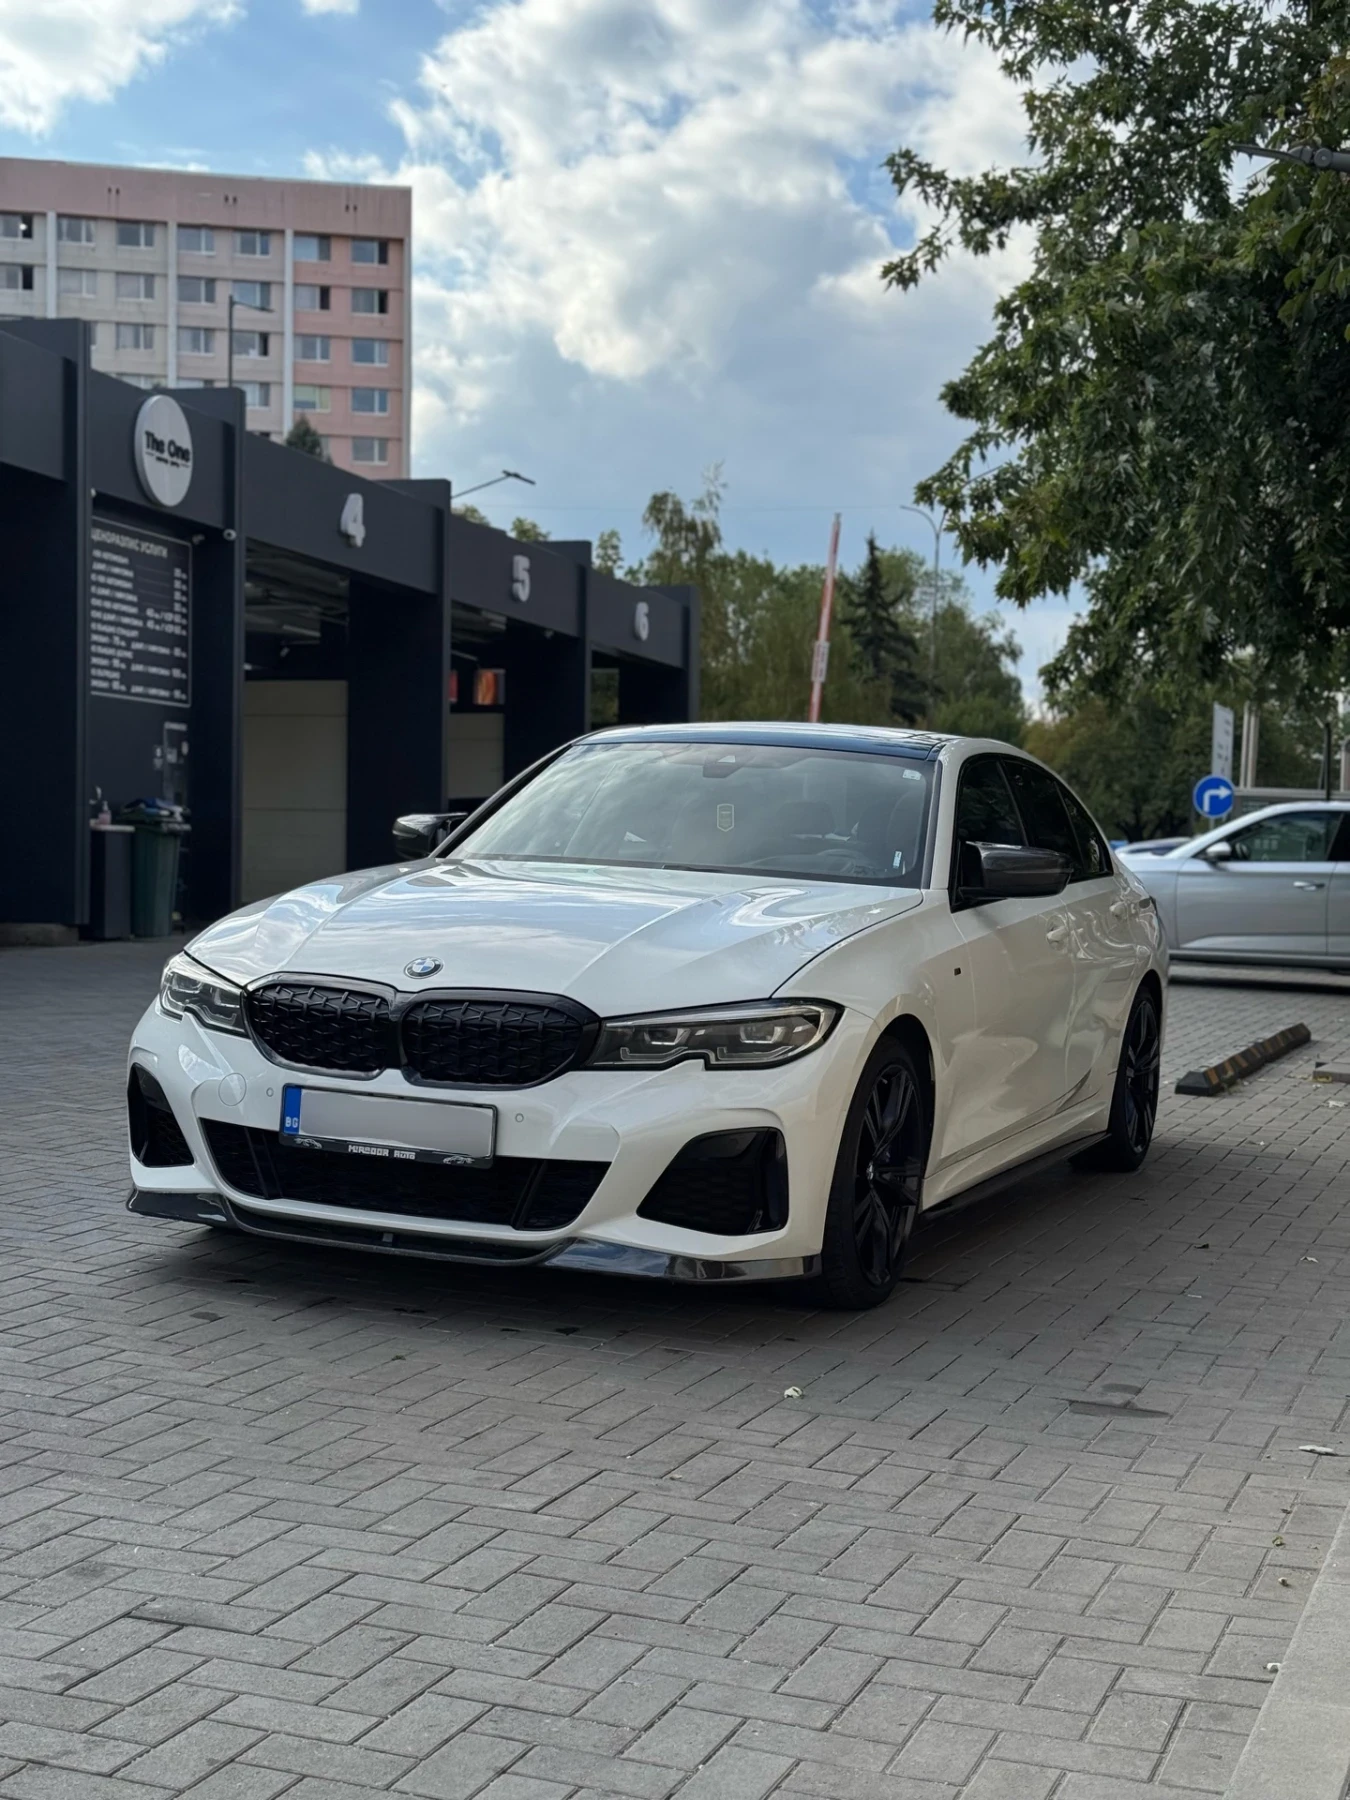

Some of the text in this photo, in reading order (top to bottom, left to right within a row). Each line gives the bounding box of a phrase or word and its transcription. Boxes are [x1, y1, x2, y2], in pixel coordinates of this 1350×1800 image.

[145, 430, 165, 454] The
[167, 439, 190, 463] One
[340, 492, 366, 548] 4
[511, 555, 531, 602] 5
[633, 601, 649, 641] 6
[285, 1116, 298, 1128] BG
